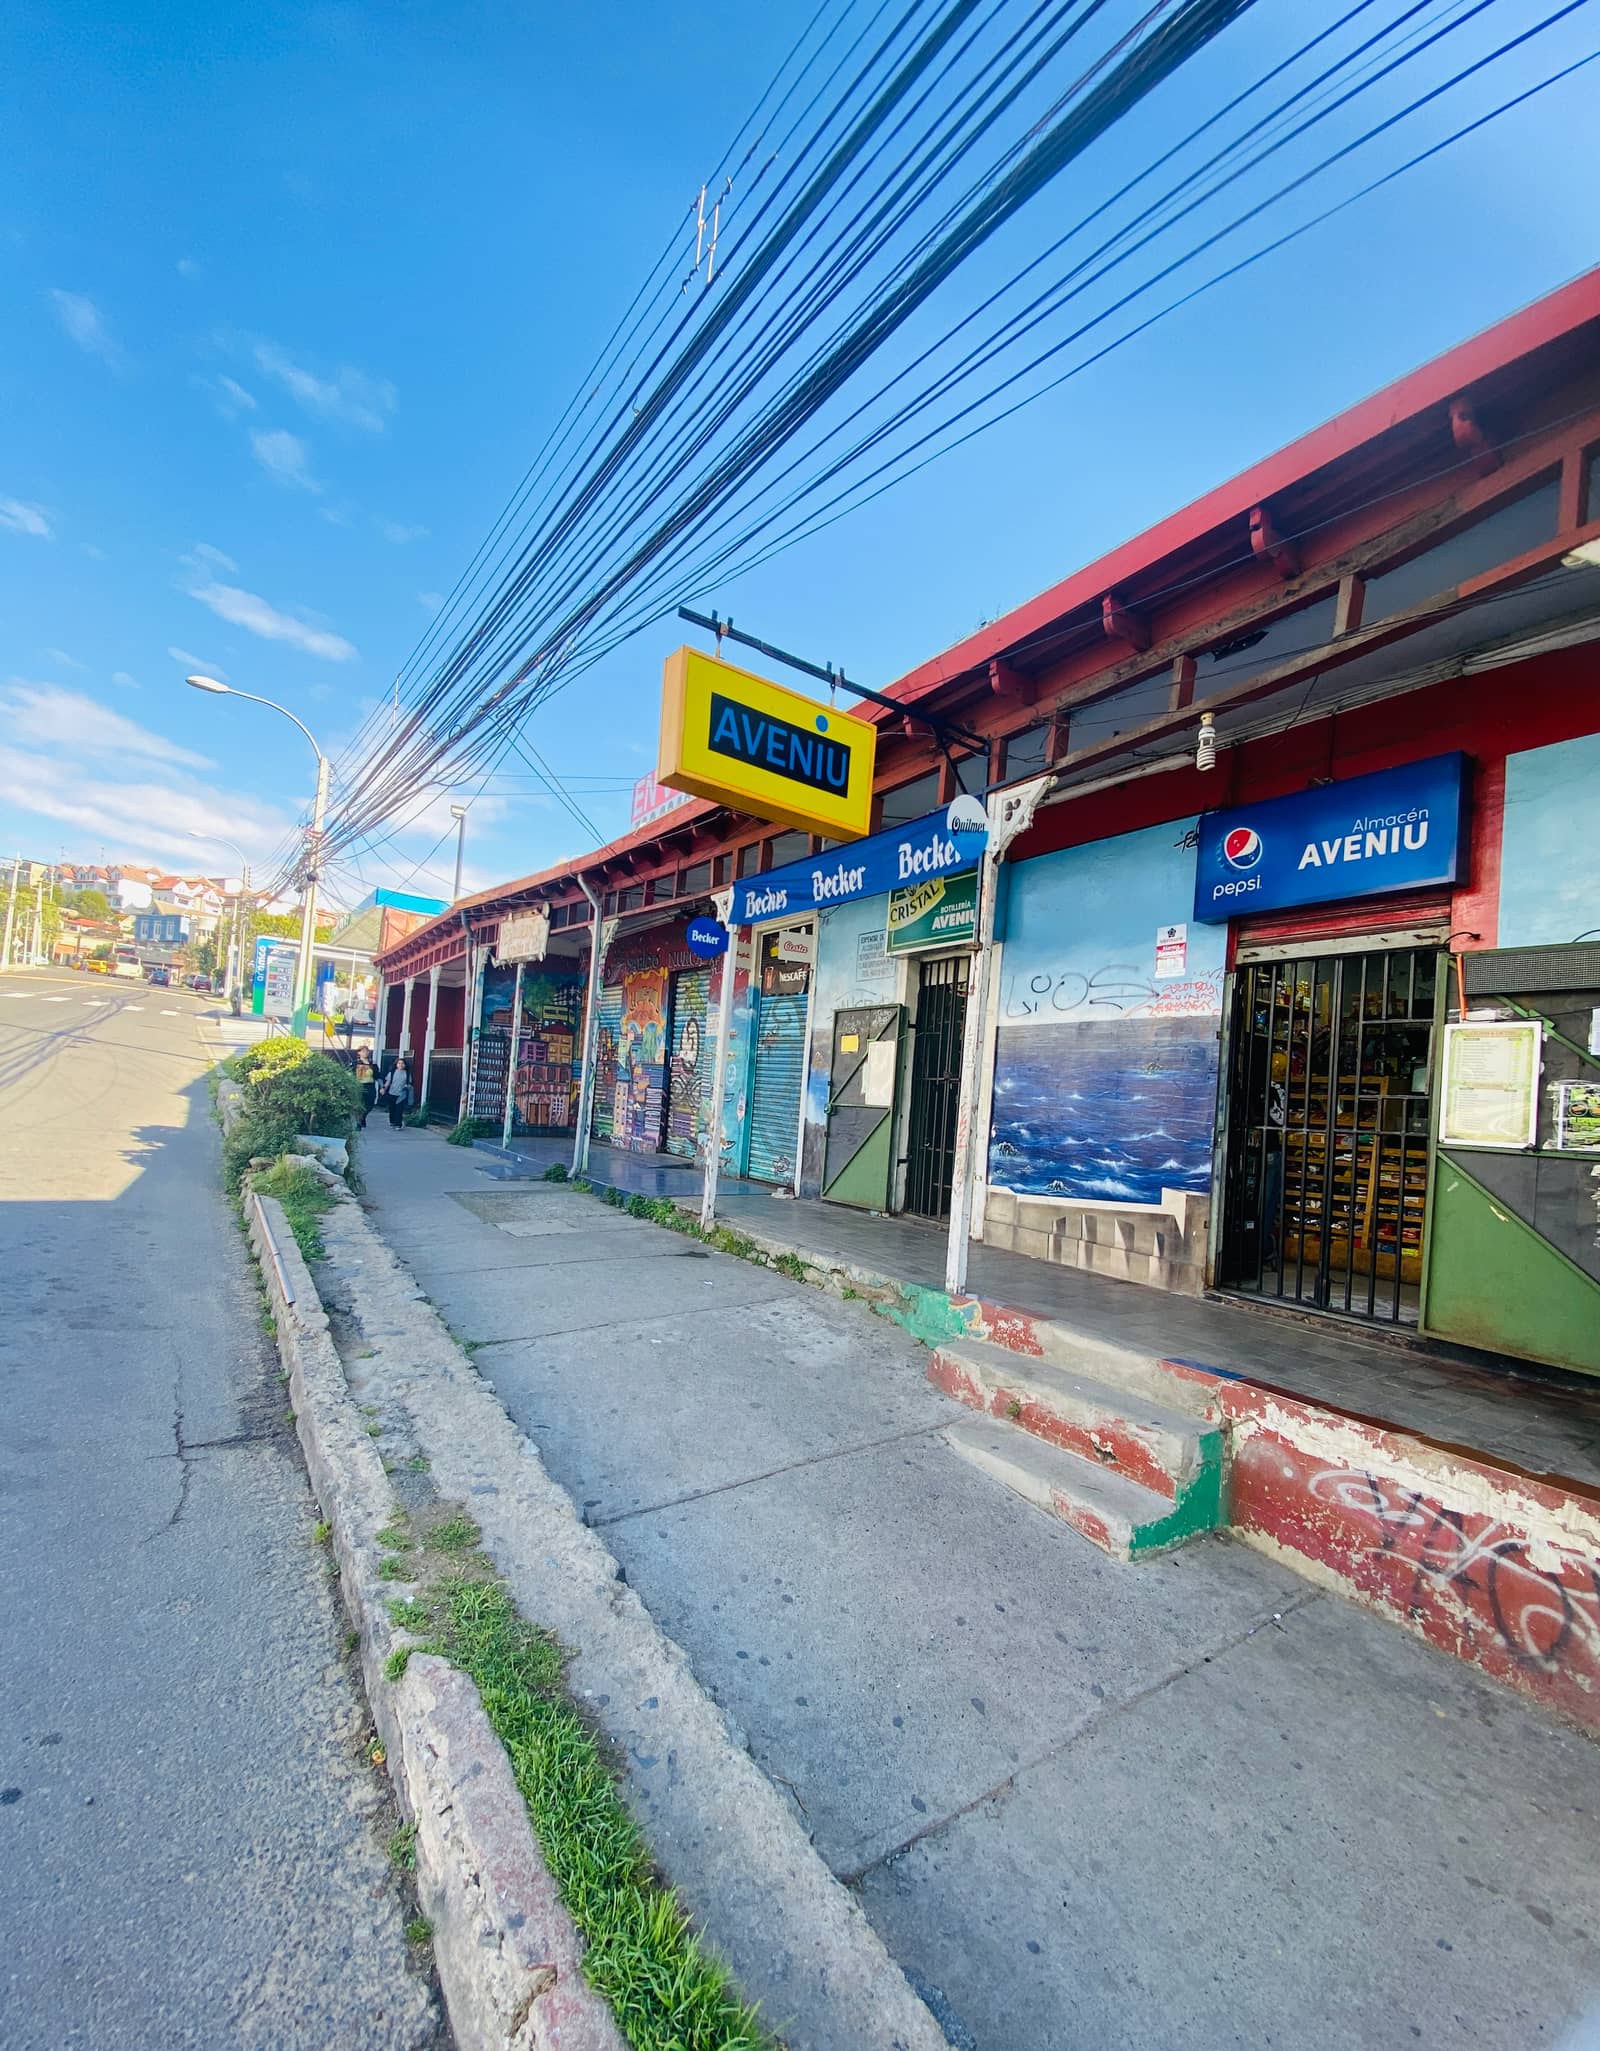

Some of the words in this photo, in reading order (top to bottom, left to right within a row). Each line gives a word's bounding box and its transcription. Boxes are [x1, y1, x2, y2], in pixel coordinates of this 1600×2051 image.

[713, 706, 847, 787] AVENIU
[1352, 808, 1429, 833] Almacén
[1297, 821, 1428, 871] AVENIU
[811, 863, 866, 902] Becker
[1212, 874, 1261, 901] pepsi
[889, 883, 940, 922] CRISTAL
[691, 929, 720, 945] Becker
[256, 945, 267, 982] aramco
